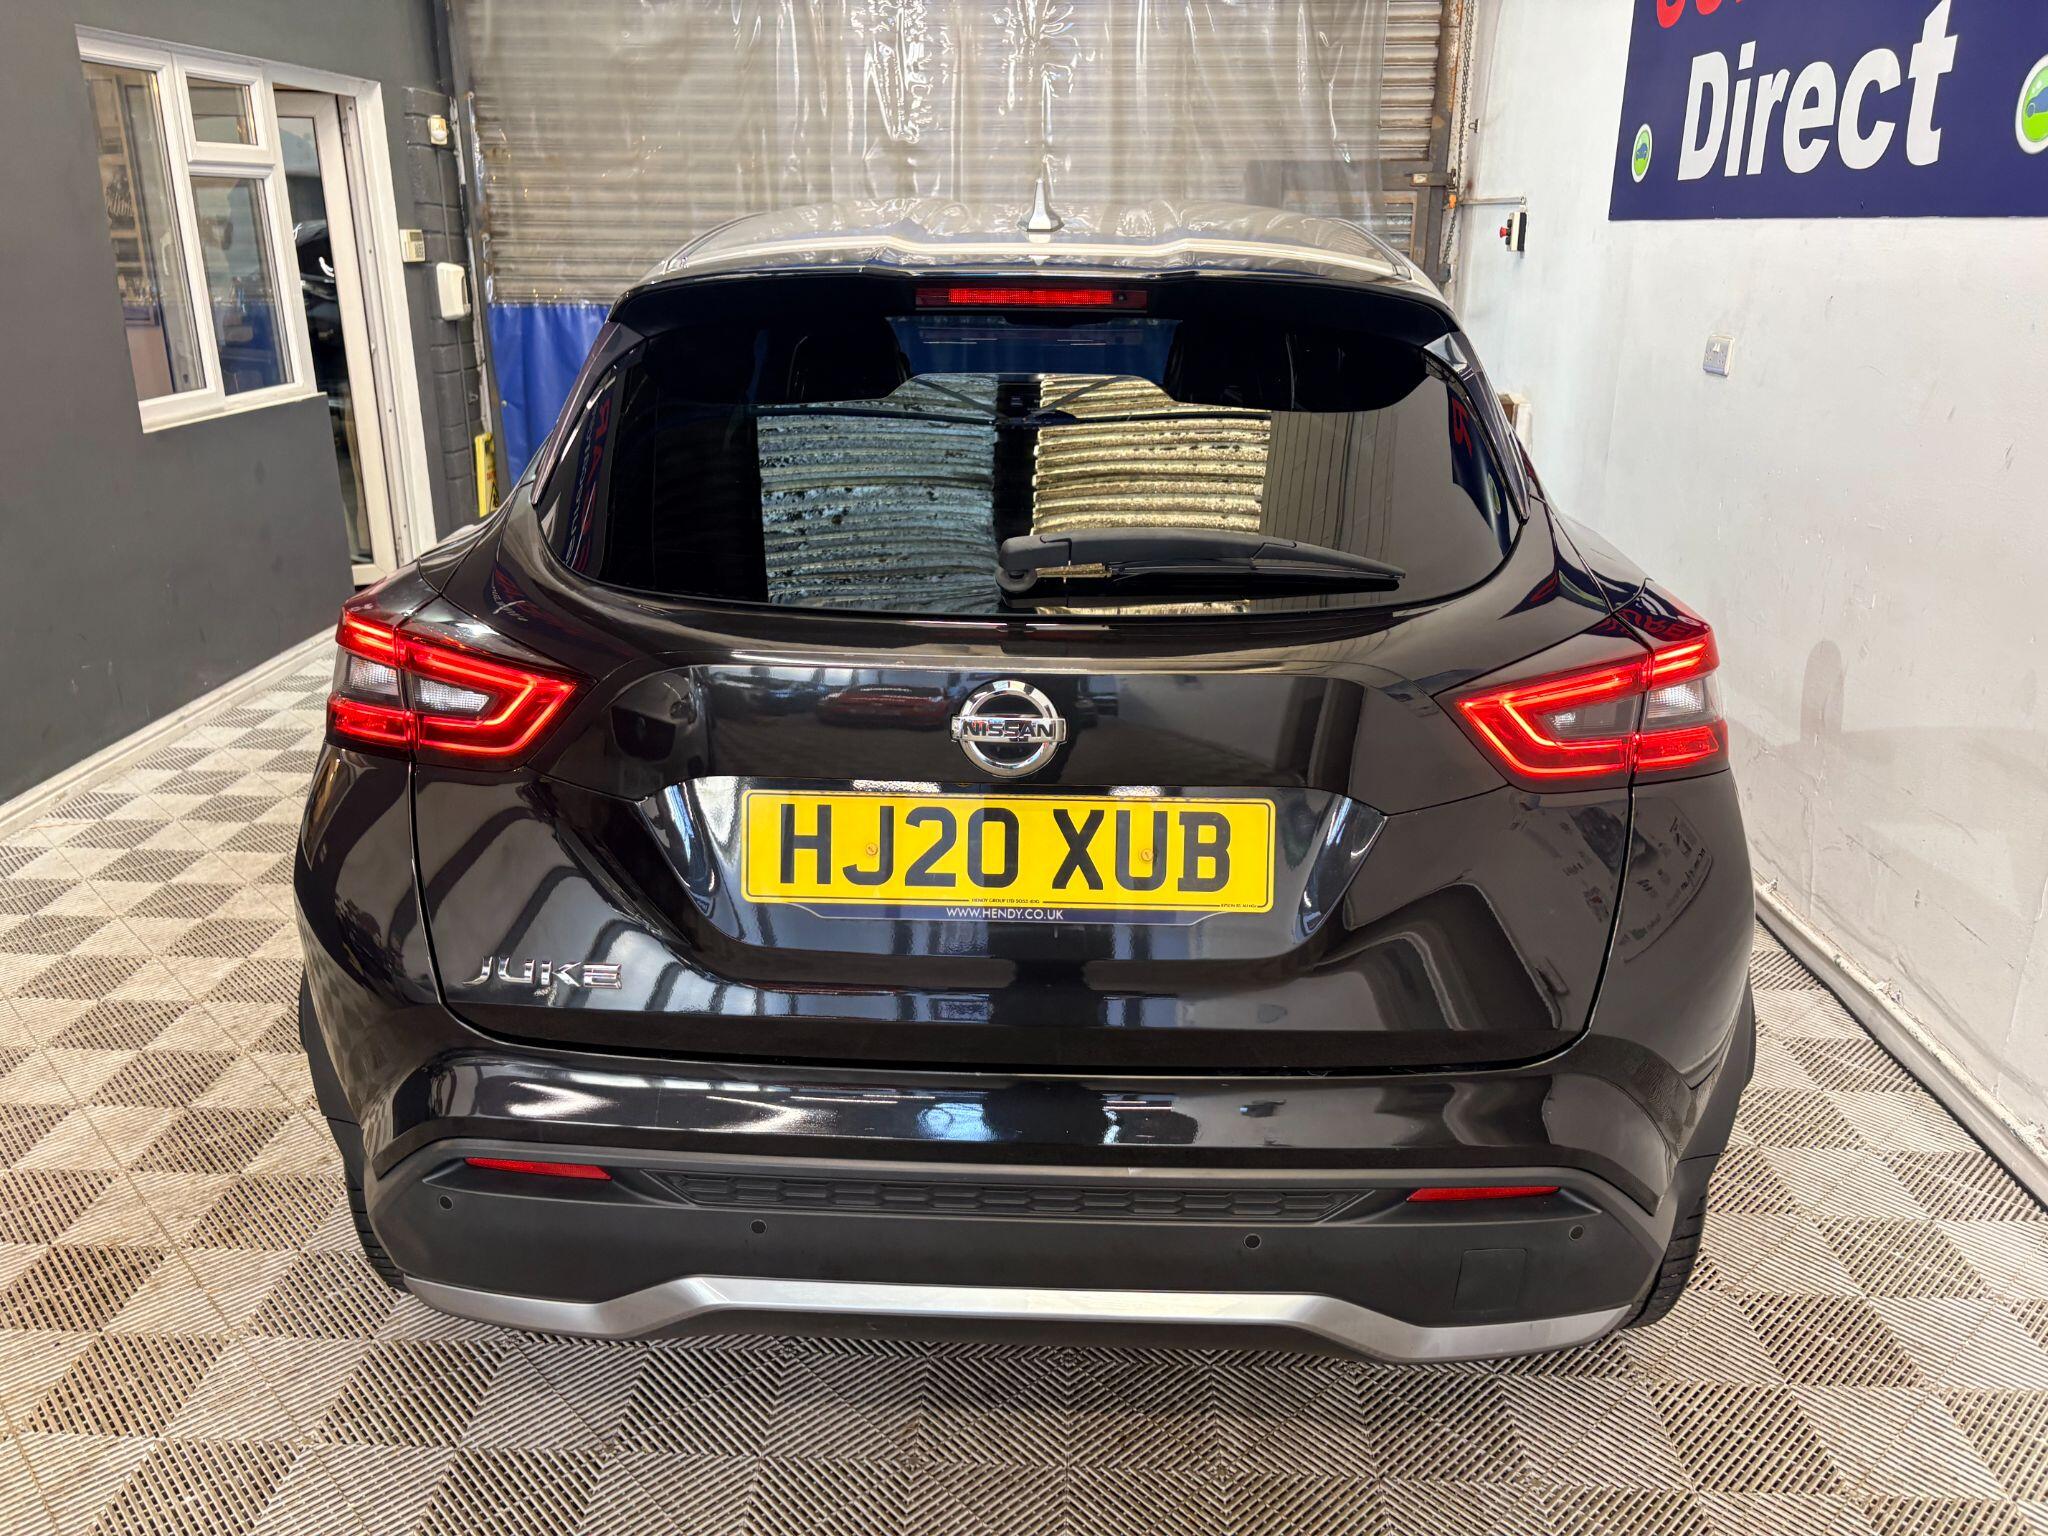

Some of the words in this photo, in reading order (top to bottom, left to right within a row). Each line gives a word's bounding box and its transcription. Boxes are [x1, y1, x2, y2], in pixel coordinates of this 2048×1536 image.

[1677, 0, 1958, 181] Direct
[962, 720, 1054, 738] NISSAN
[780, 803, 1020, 889] HJ20
[1052, 809, 1231, 893] XUB
[946, 907, 1064, 920] WWW.HENDY.CO.UK
[462, 956, 622, 989] JUKE
